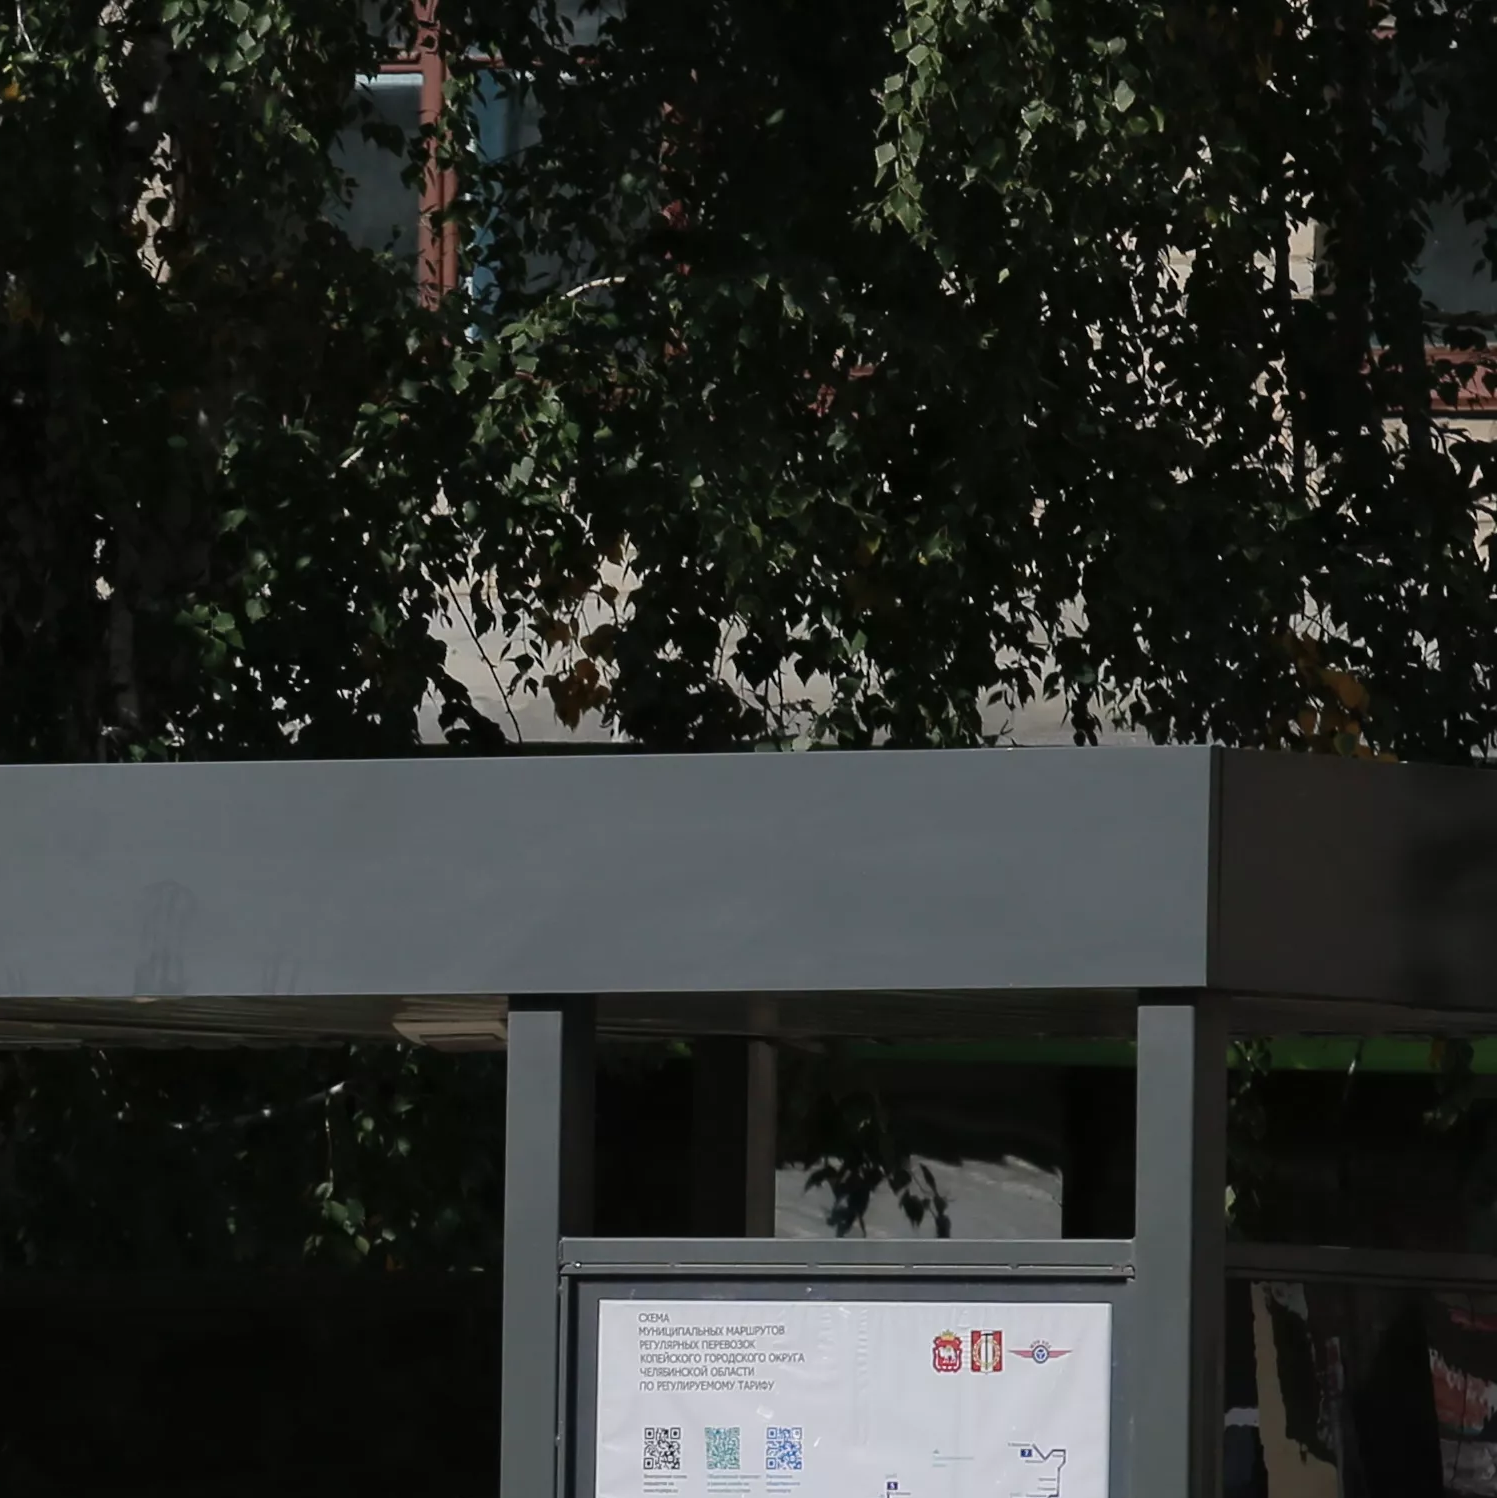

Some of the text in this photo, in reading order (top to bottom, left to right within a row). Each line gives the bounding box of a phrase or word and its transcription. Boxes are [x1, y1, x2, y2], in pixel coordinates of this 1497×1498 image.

[638, 1313, 670, 1323] СХЕМА
[638, 1325, 785, 1338] МУНИЦИПАЛЬНЫХ МАРШРУТОВ
[639, 1339, 756, 1350] РЕГУЛЯРНЫХ ПЕРЕВОЗОК
[640, 1351, 805, 1364] КОПЕЙСКОГО ГОРОДСКОГО ОКРУГА
[640, 1365, 755, 1377] ЧЕЛЯБИНСКОЙ ОБЛАСТИ
[639, 1380, 775, 1391] ПО РЕГУЛИРУЕМОМУ ТАРИФУ
